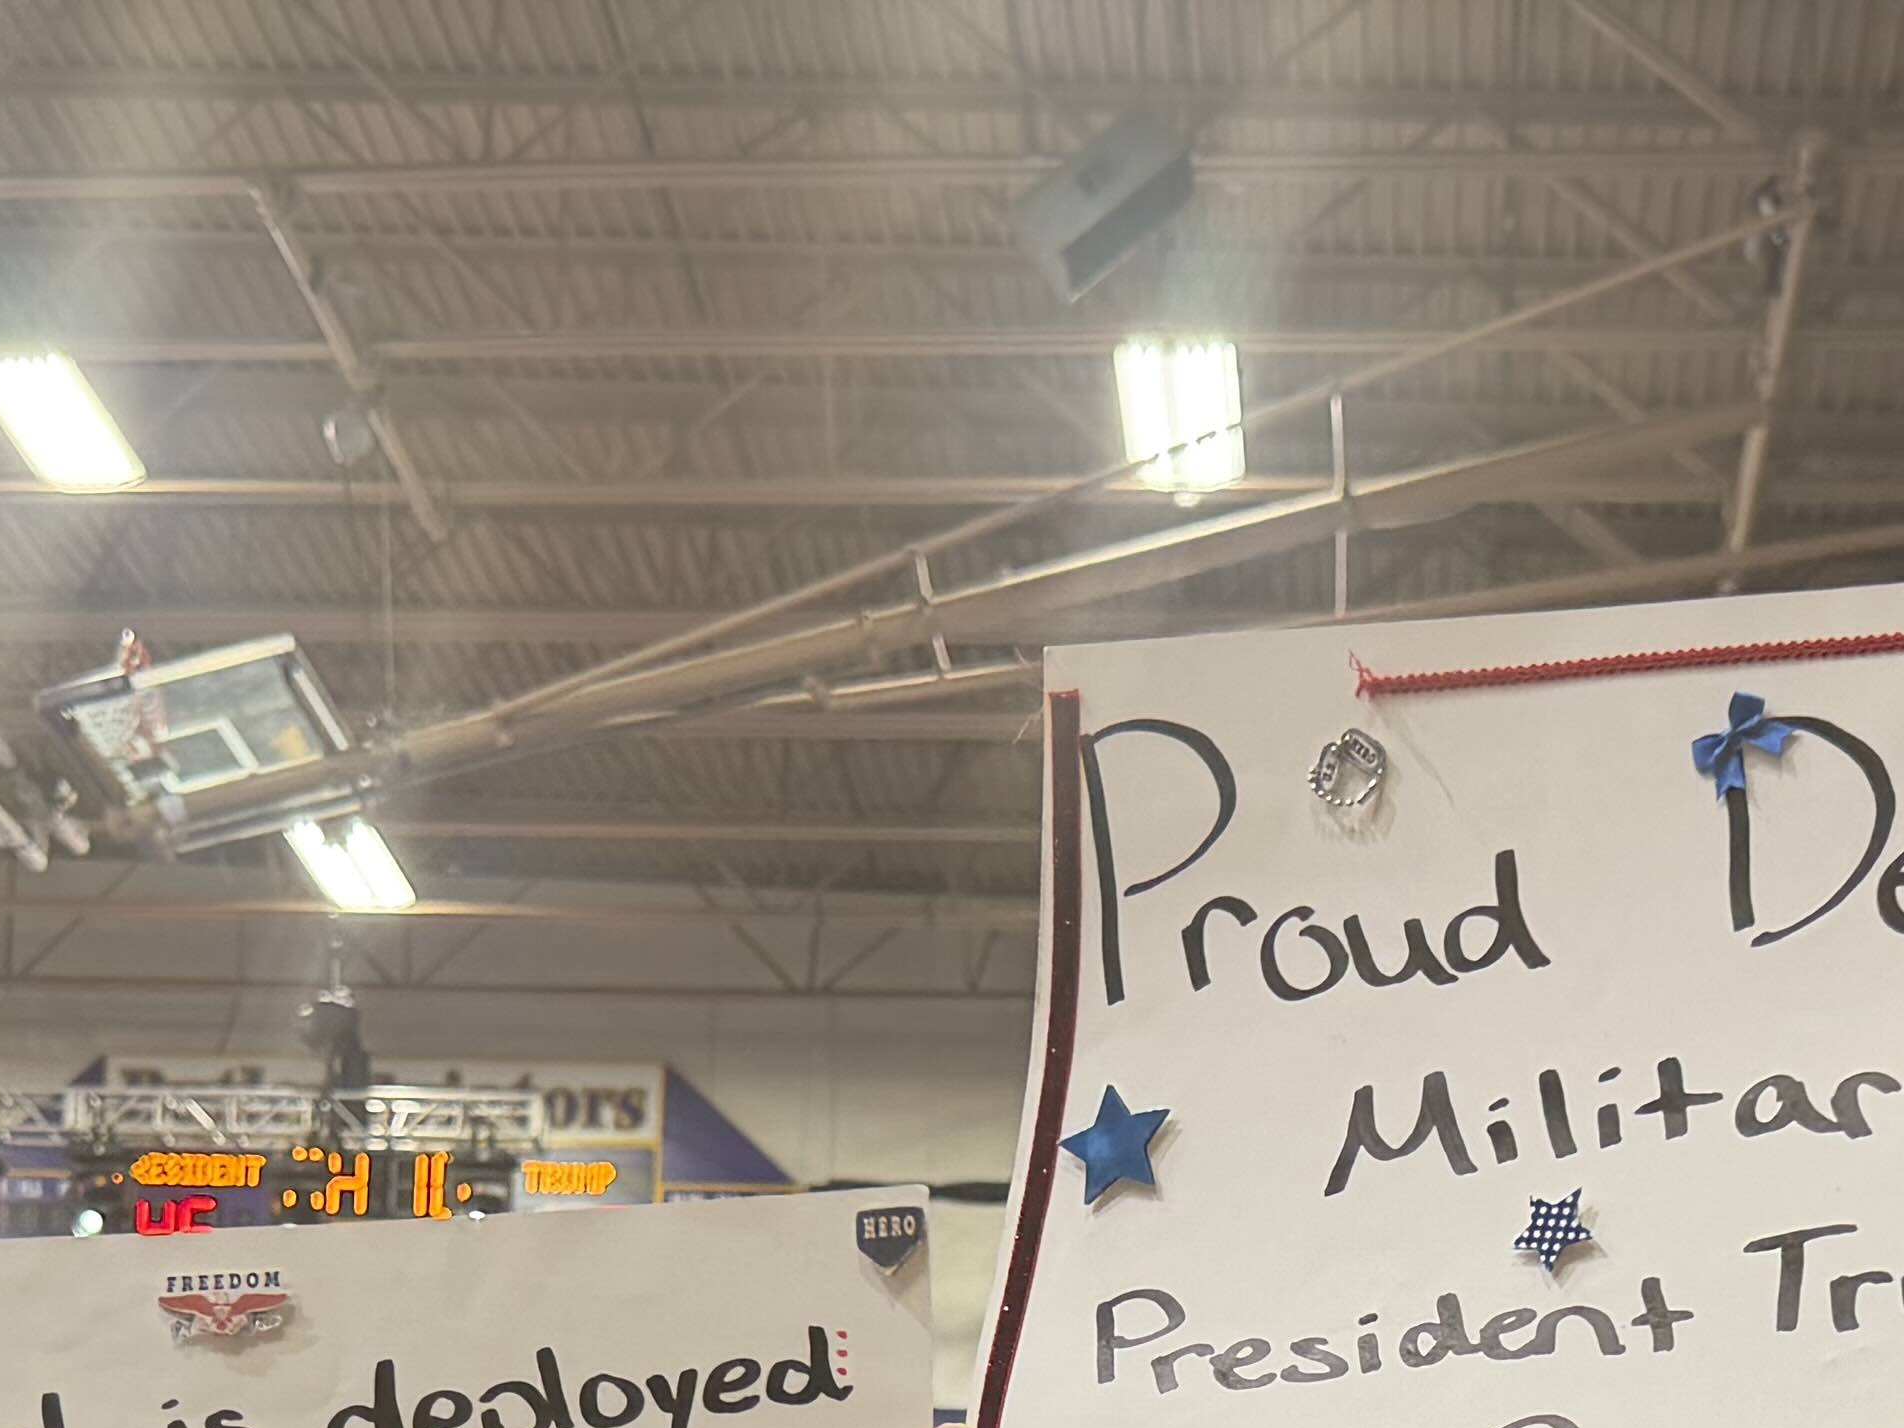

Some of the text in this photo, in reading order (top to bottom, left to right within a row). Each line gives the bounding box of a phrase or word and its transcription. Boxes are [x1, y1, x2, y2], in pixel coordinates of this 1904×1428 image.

[1081, 719, 1550, 1004] Proud
[863, 1215, 916, 1239] HERO
[166, 1271, 281, 1293] FREEDOM
[1097, 1278, 1694, 1393] President
